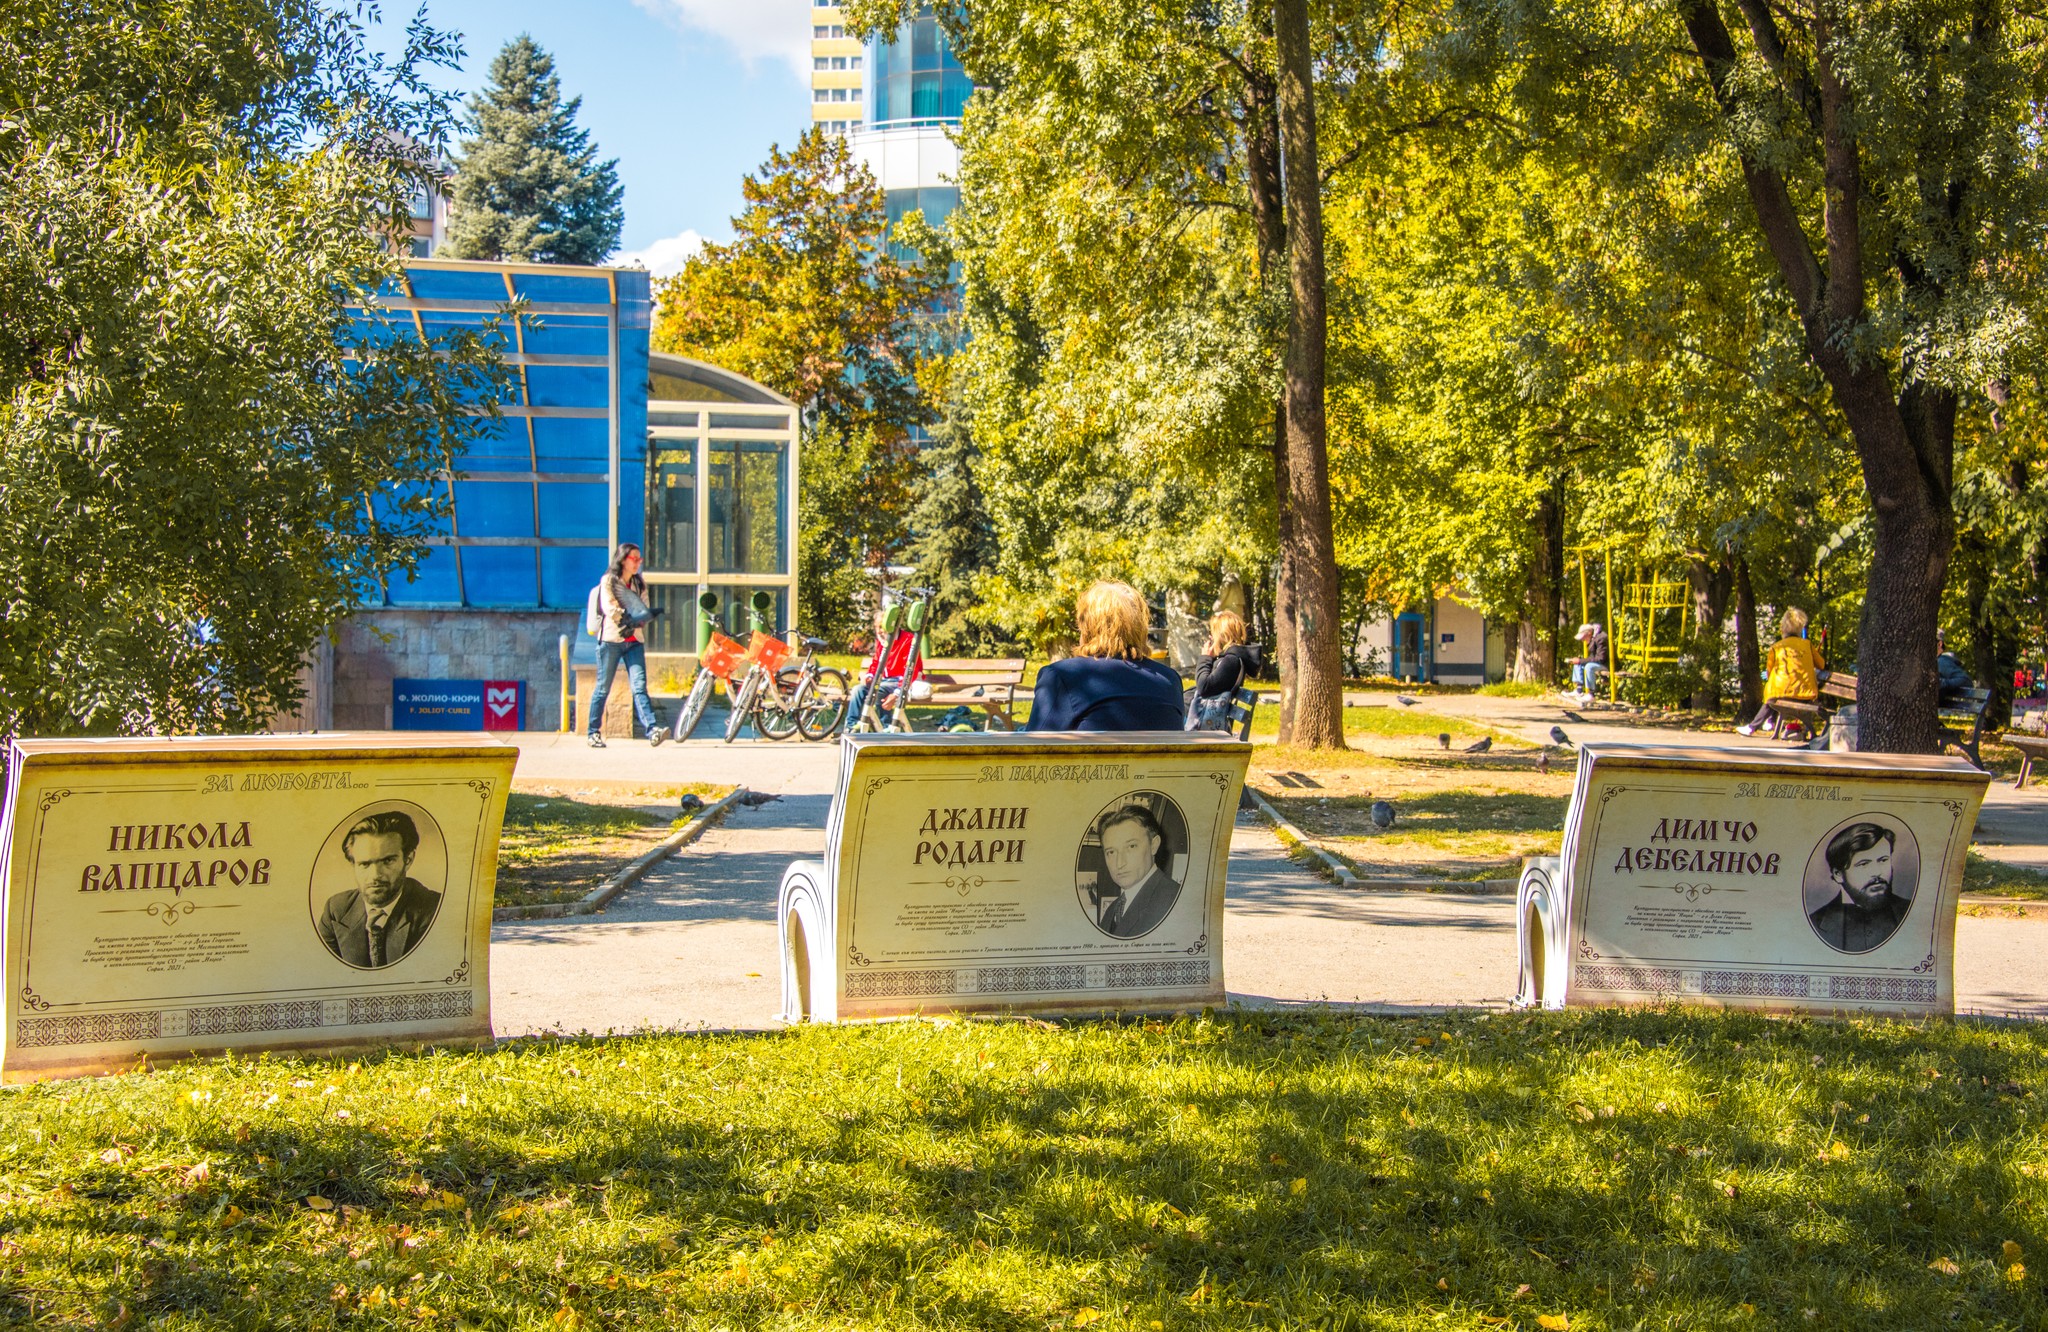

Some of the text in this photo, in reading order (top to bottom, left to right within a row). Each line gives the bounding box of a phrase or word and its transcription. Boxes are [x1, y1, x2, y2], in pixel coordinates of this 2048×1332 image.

[398, 694, 480, 702] Ф. ЖОЛИО-КЮРИ
[202, 774, 234, 795] ЗА
[977, 766, 1004, 784] ЗА
[1009, 764, 1130, 784] НАДЕЖДАТА
[1734, 782, 1761, 798] ЗА
[918, 807, 1030, 836] ДЖАНИ
[1651, 817, 1758, 844] ДИМЧО
[106, 821, 254, 852] НИКОЛА
[912, 838, 1026, 869] РОДАРИ
[1614, 846, 1781, 876] ДЕБЕЛЯНОВ
[78, 858, 271, 897] ВАПЦАРОВ
